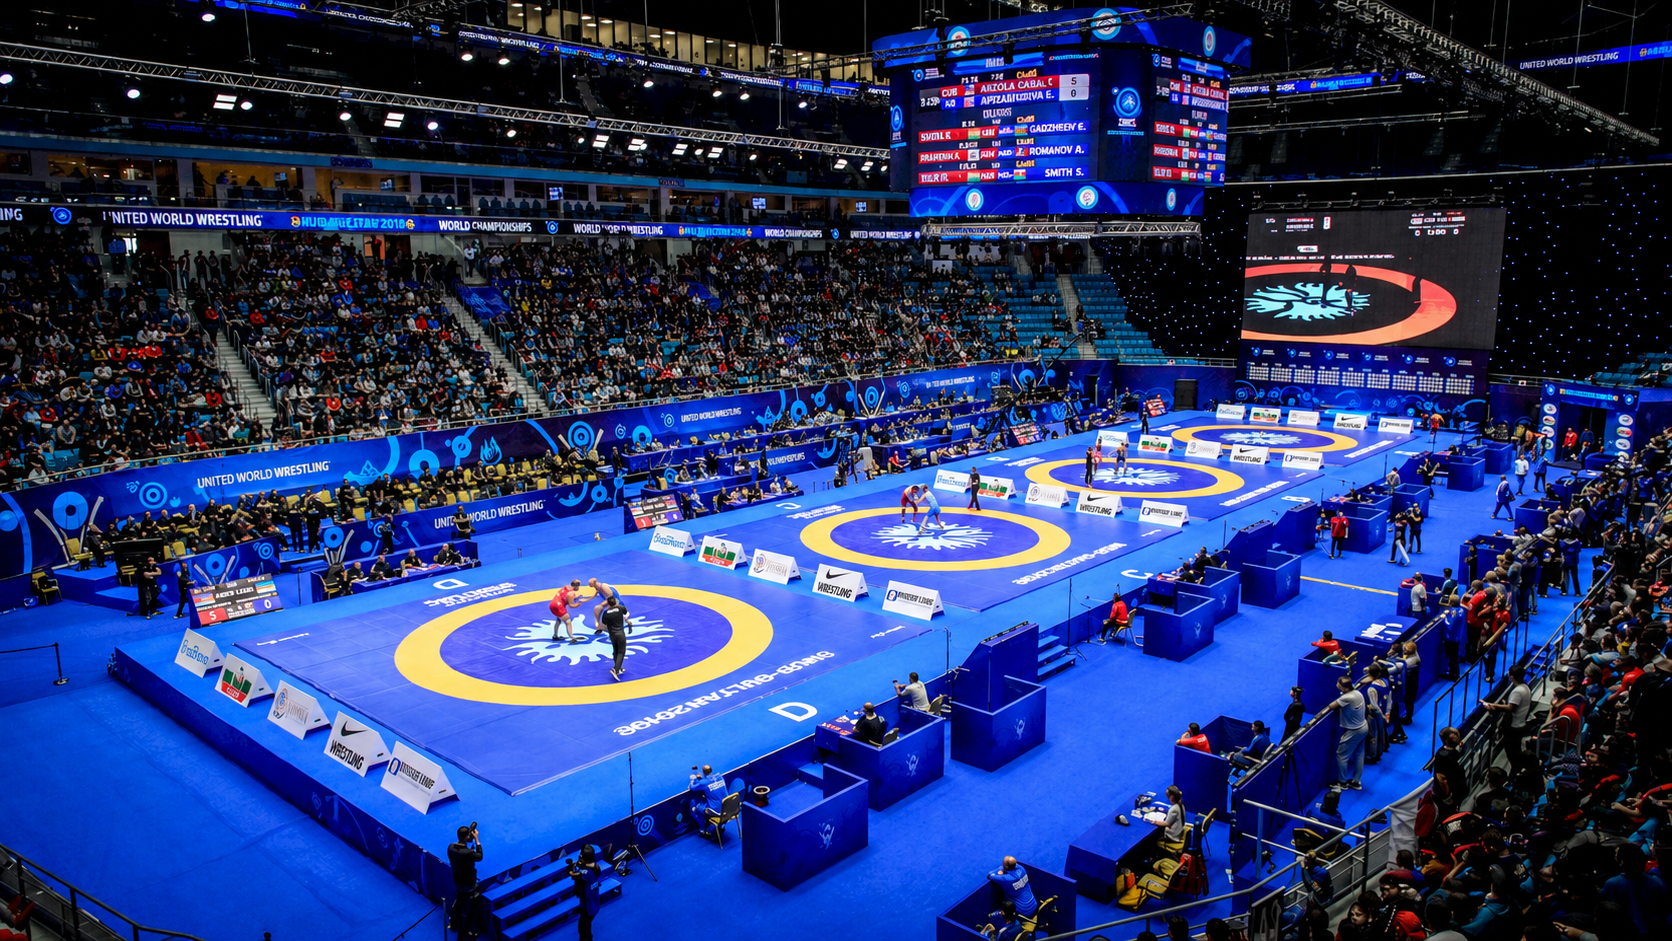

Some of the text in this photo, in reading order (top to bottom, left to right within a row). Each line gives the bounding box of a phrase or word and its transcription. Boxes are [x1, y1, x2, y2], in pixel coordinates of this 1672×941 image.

[1547, 56, 1574, 66] WORLD
[1044, 169, 1073, 178] SMITH
[150, 212, 194, 225] WORLD
[195, 213, 262, 227] WRESTLING
[438, 220, 471, 231] WORLD
[196, 461, 329, 489] UNITED WORLD WRESTLING
[497, 499, 544, 518] WRESTLING
[264, 599, 272, 609] 0
[768, 701, 818, 722] D
